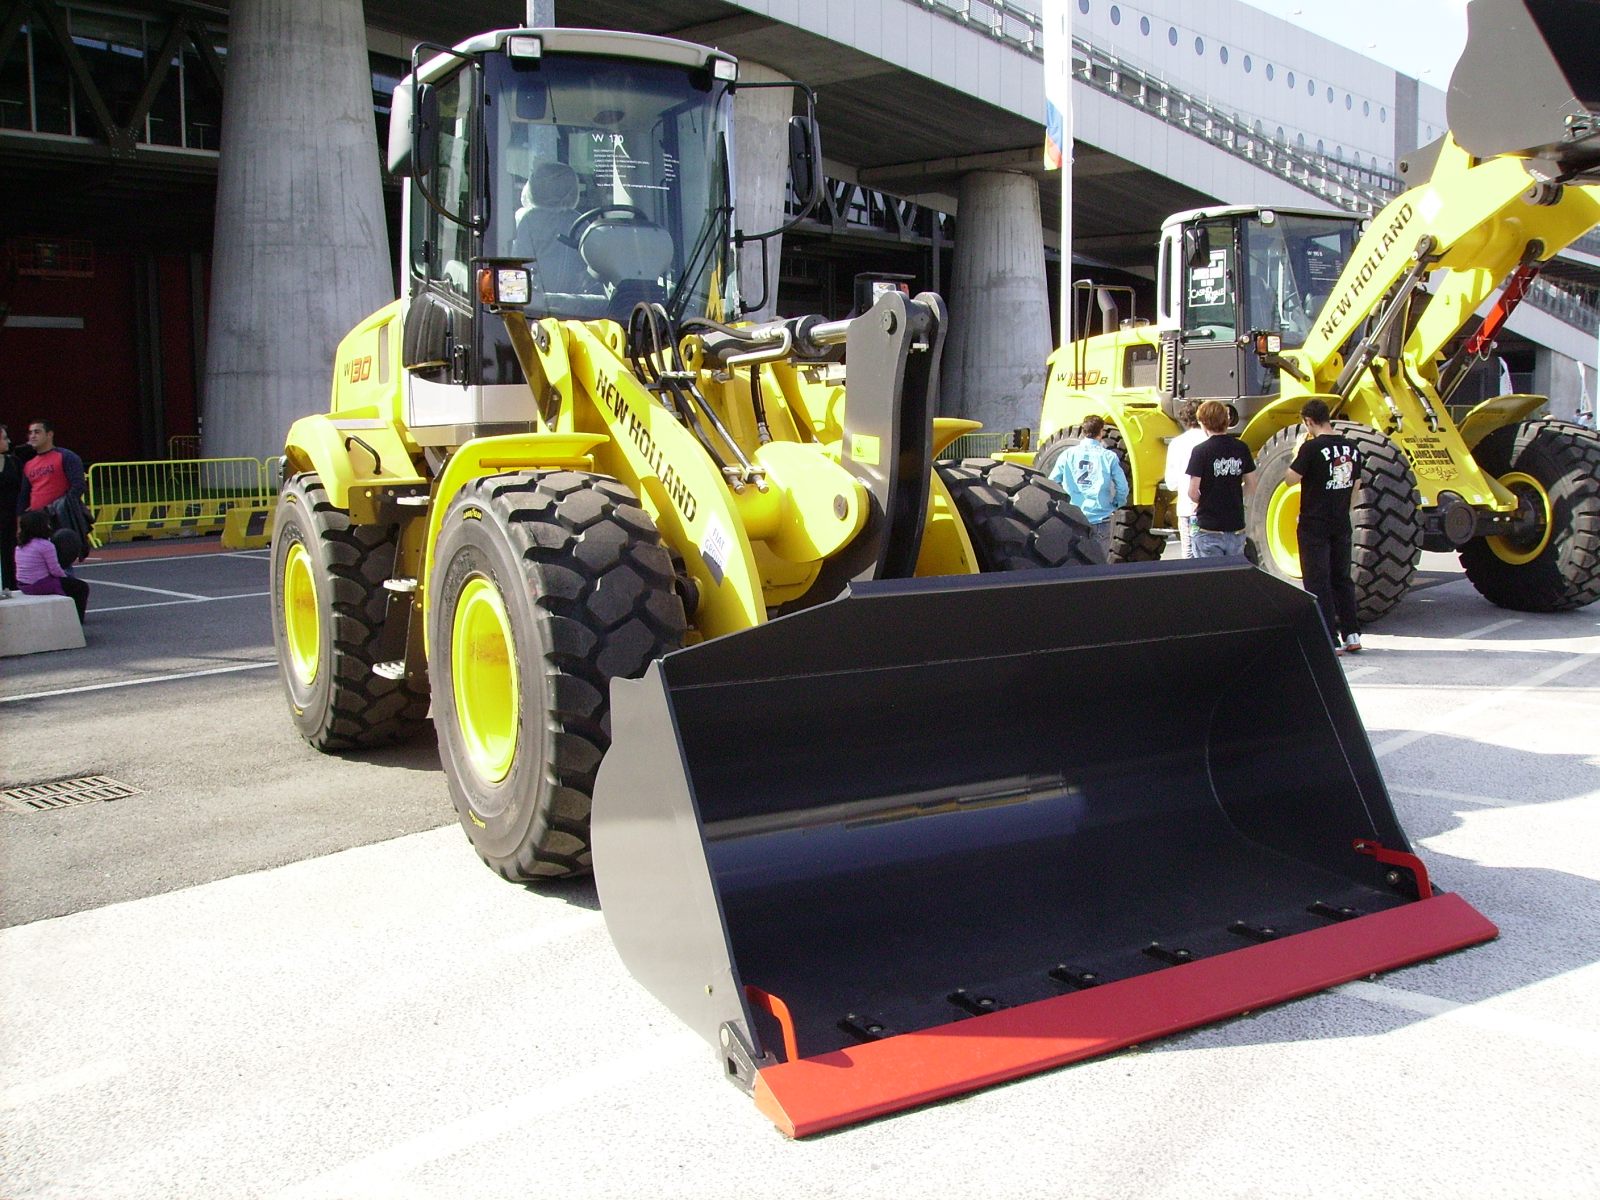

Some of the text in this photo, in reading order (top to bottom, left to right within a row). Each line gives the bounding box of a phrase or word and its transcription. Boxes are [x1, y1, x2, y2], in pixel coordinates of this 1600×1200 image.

[592, 133, 604, 143] W
[1320, 292, 1352, 341] NEW
[1350, 202, 1413, 297] HOLLAND
[596, 368, 697, 523] NEW HOLLAND
[1320, 445, 1359, 462] PARA
[1077, 459, 1094, 485] 2
